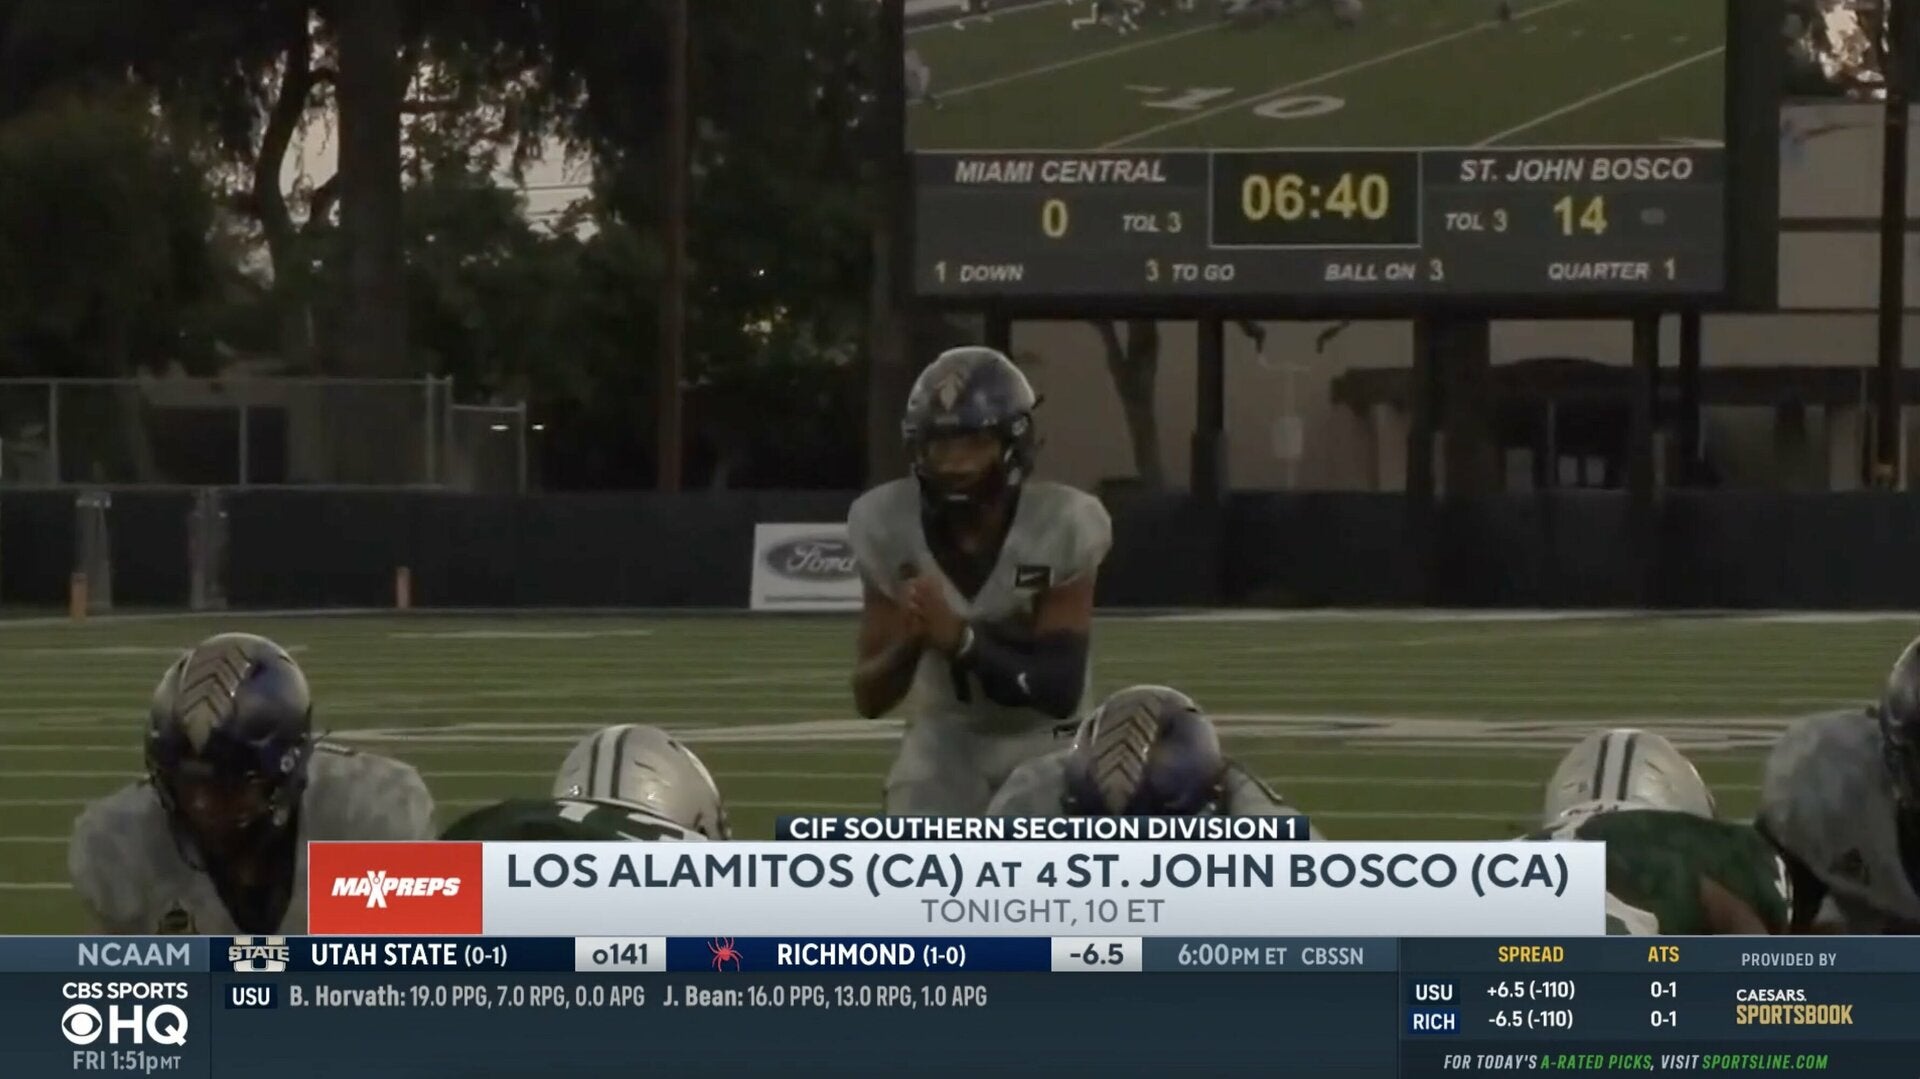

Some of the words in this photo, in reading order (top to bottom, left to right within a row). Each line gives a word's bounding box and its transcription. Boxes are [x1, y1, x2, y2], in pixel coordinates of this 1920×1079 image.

[955, 160, 1035, 183] MIAMI
[1040, 159, 1166, 183] CENTRAL
[1459, 158, 1498, 182] ST.
[1505, 157, 1585, 182] JOHN
[1590, 156, 1693, 181] BOSCO
[1241, 172, 1389, 221] 06:40
[1042, 198, 1069, 238] 0
[1122, 213, 1161, 233] TOL
[1167, 211, 1182, 234] 3
[1444, 211, 1485, 231] TOL
[1493, 208, 1508, 233] 3
[1553, 195, 1608, 236] 14
[935, 261, 947, 283] 1
[959, 264, 1024, 283] DOWN
[1146, 258, 1160, 282] 3
[1171, 263, 1199, 282] TO
[1203, 263, 1235, 282] GO
[1324, 263, 1378, 282] BALL
[1384, 262, 1417, 281] ON
[1429, 258, 1444, 281] 3
[1547, 261, 1650, 281] QUARTER
[1664, 257, 1676, 280] 1
